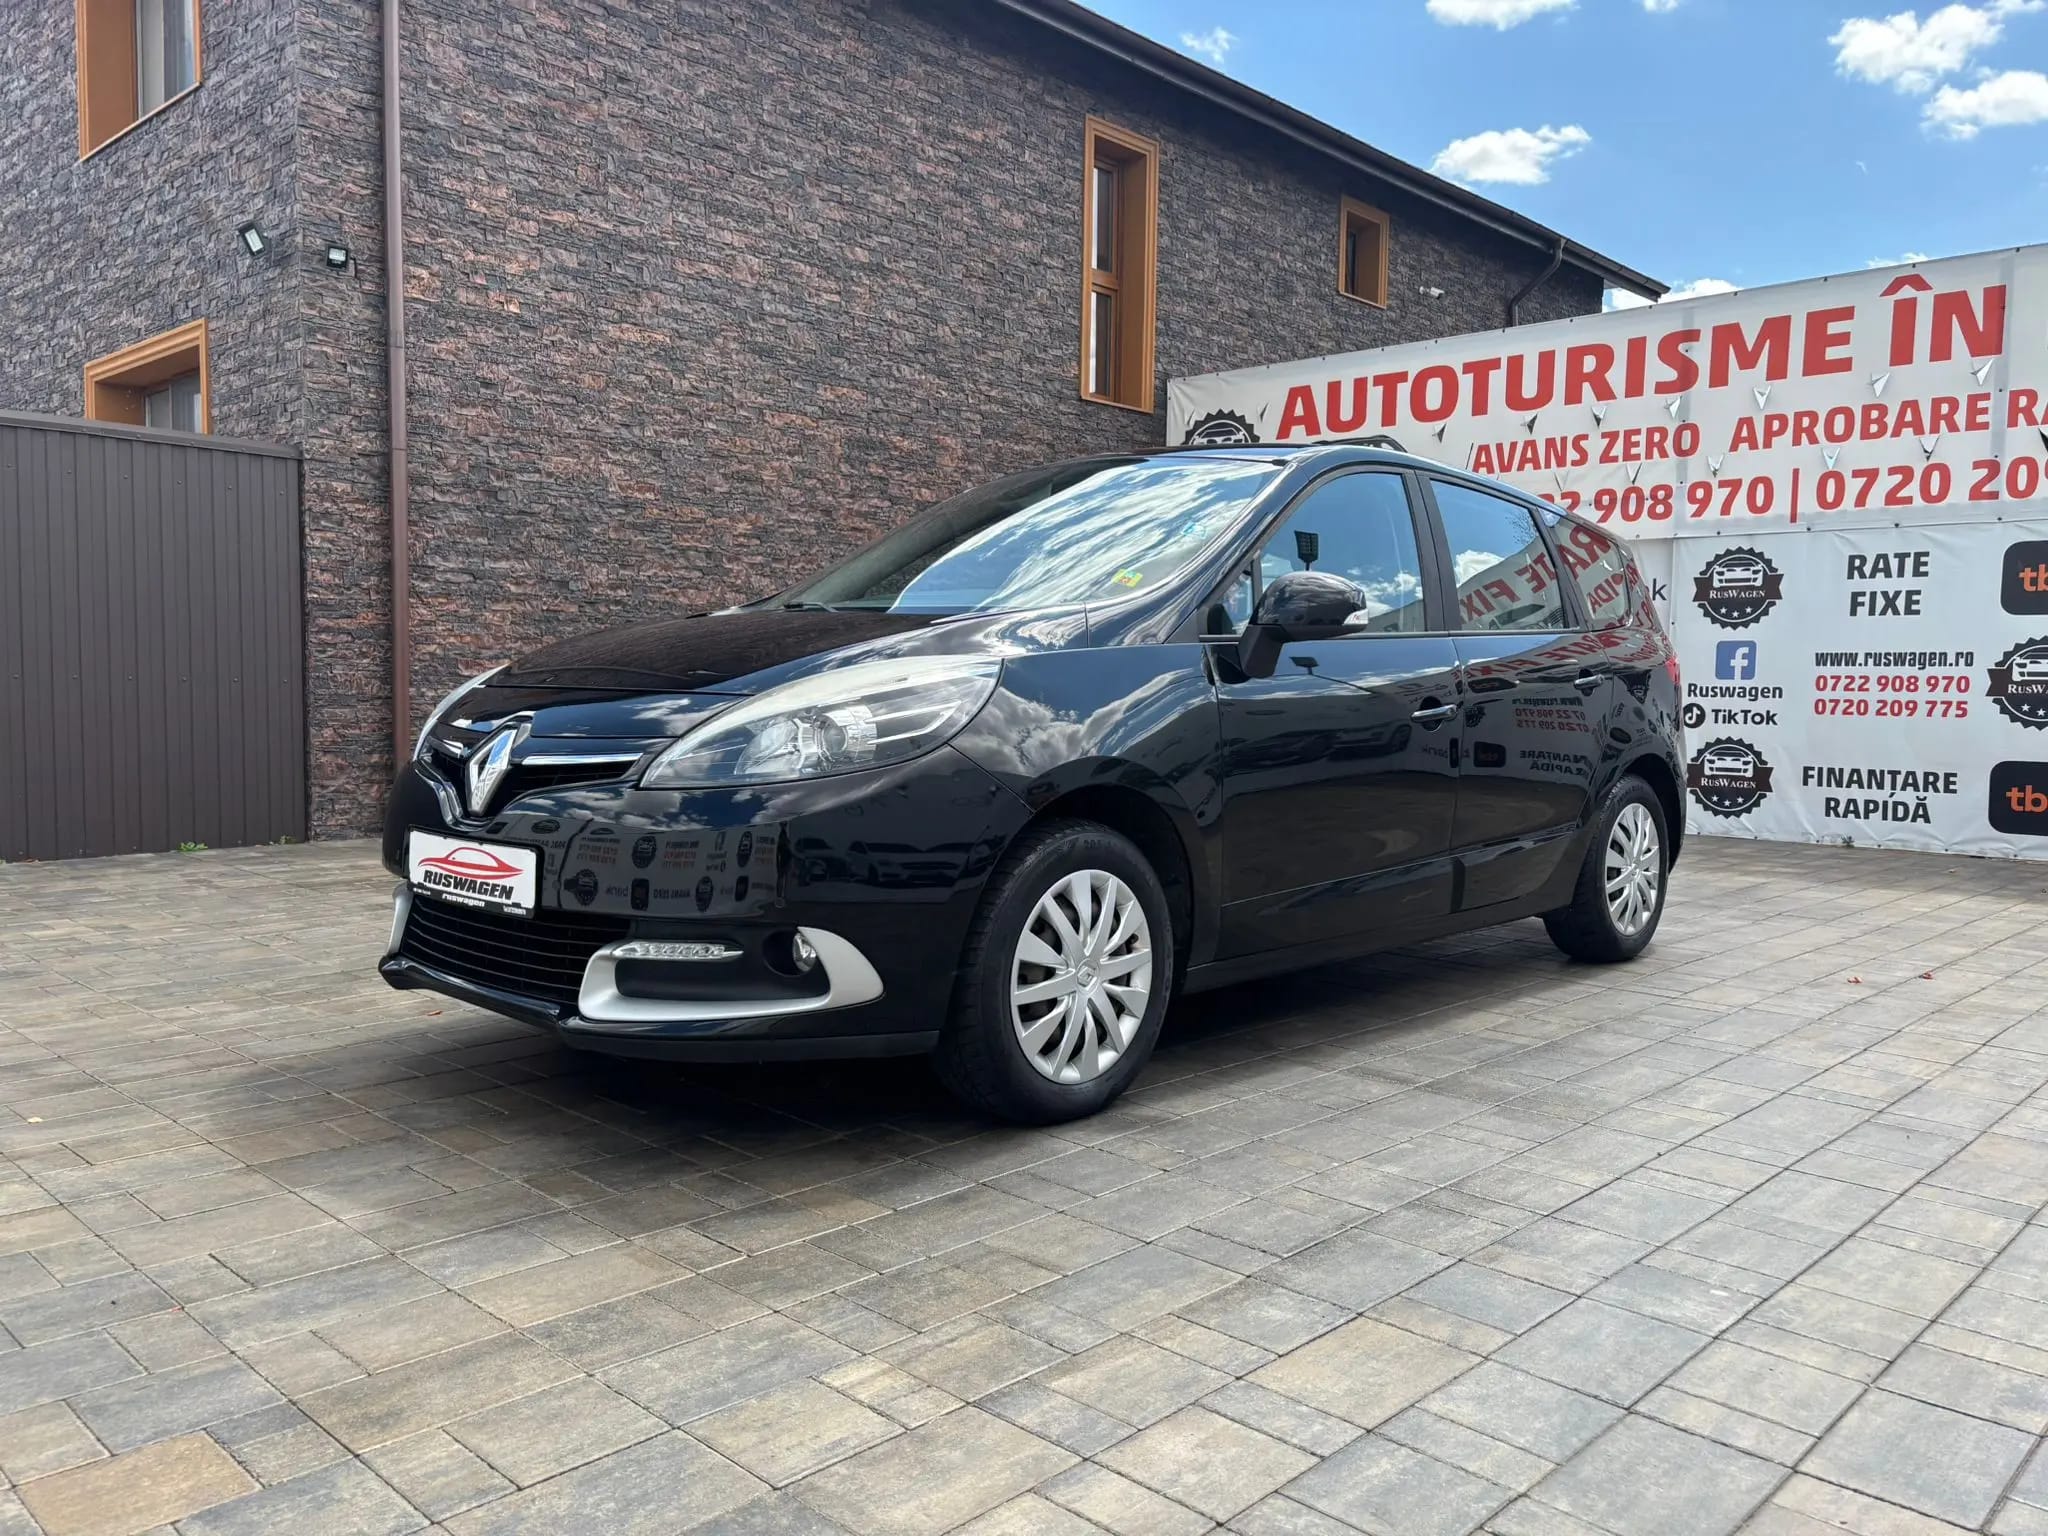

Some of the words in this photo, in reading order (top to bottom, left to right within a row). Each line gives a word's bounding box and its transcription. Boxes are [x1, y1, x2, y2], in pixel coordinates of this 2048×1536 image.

[1276, 306, 1855, 440] AUTOTURISME
[1880, 273, 2006, 367] ÎN
[1472, 434, 1589, 474] AVANS
[1600, 423, 1700, 464] ZERO
[1729, 392, 1991, 453] APROBARE
[2006, 389, 2048, 428] R
[1594, 484, 1674, 523] 908
[1687, 475, 1774, 520] 970
[1816, 462, 1951, 510] 0720
[1968, 456, 2048, 501] 20
[1847, 551, 1930, 580] RATE
[1849, 589, 1922, 617] FIXE
[1815, 651, 1974, 670] www.ruswagen.ro
[1687, 683, 1783, 701] Ruswagen
[1815, 675, 1870, 692] 0722
[1876, 675, 1919, 693] 908
[1925, 676, 1970, 693] 970
[1711, 709, 1778, 725] TikTok
[1814, 699, 1869, 715] 0720
[1875, 699, 1918, 717] 209
[1925, 700, 1968, 718] 775
[423, 870, 514, 901] RUSWAGEN
